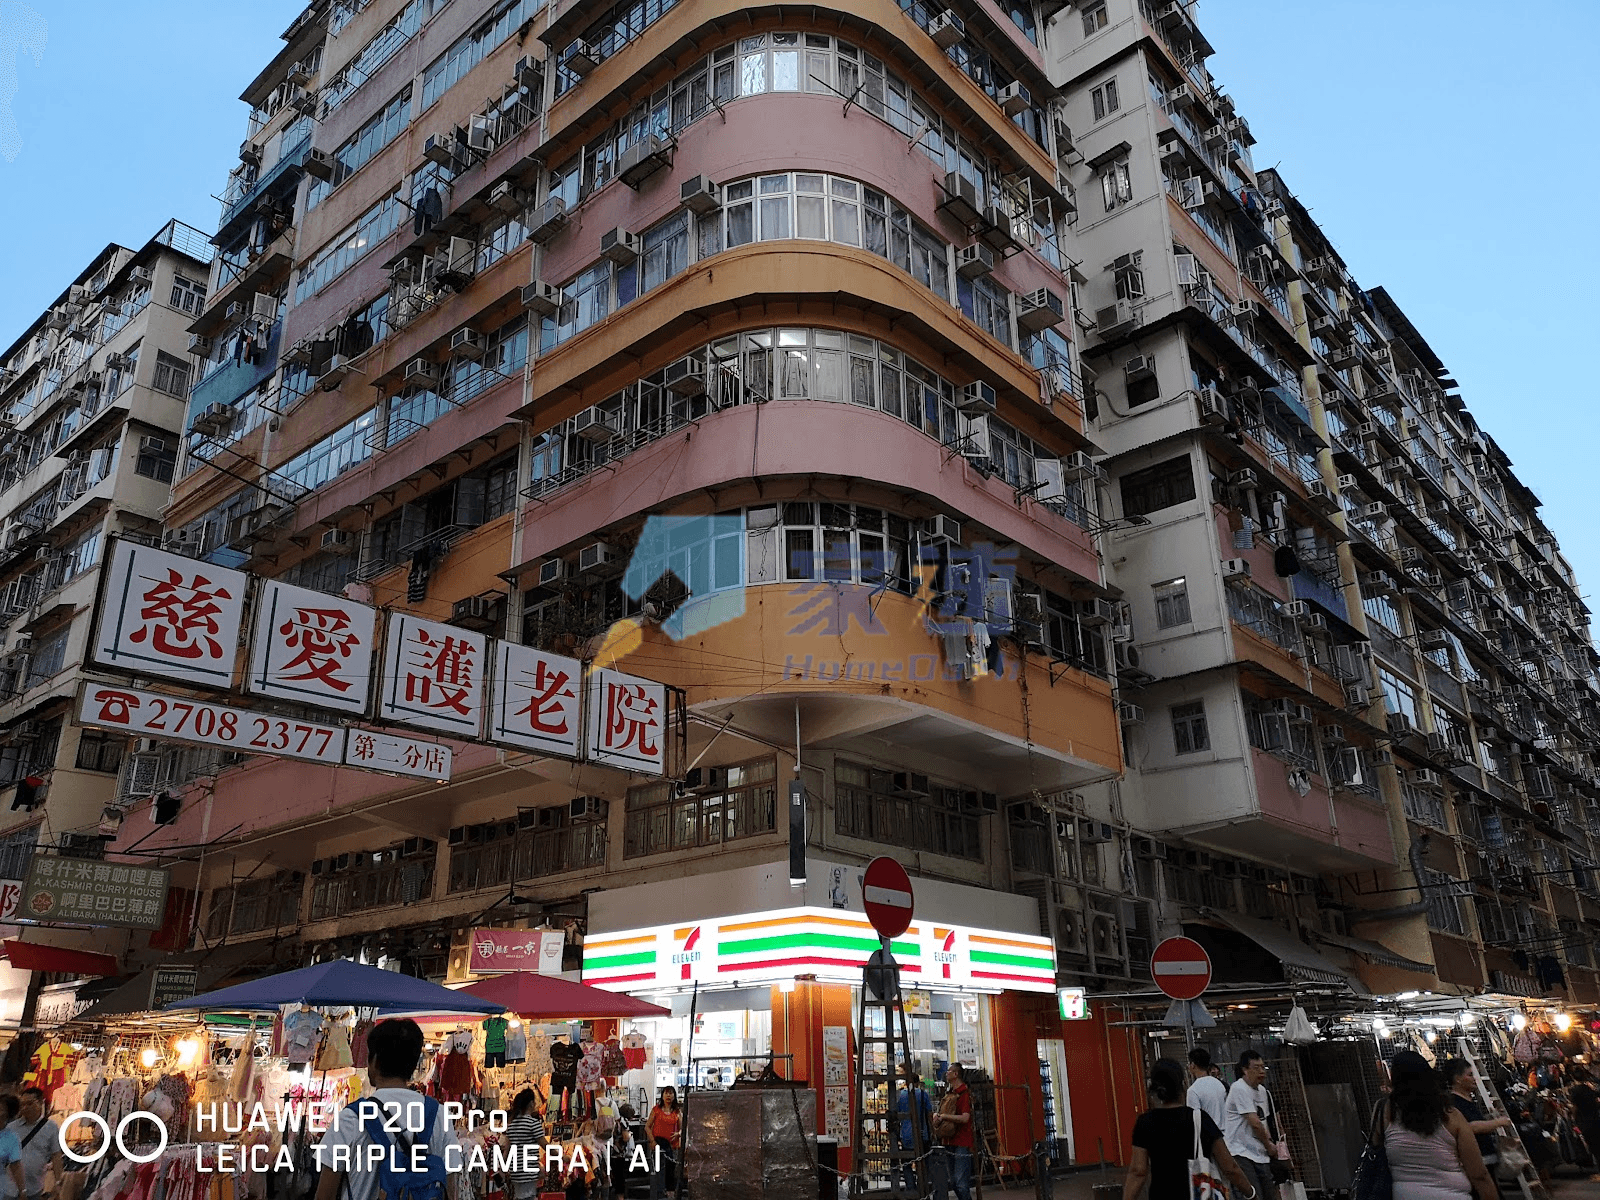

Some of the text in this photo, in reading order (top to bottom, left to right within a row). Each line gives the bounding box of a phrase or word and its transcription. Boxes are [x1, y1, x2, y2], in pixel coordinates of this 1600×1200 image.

[129, 567, 658, 757] 慈愛護老院
[145, 699, 333, 757] 2708 2377
[353, 733, 445, 774] 第二分店
[34, 878, 162, 898] A.KASHMIR CURRY HOUSE
[36, 858, 164, 888] 喀什米爾咖哩屋
[58, 909, 157, 925] ALIBABA (HALAL FOOD)
[60, 892, 160, 916] 啊里巴巴薄餅
